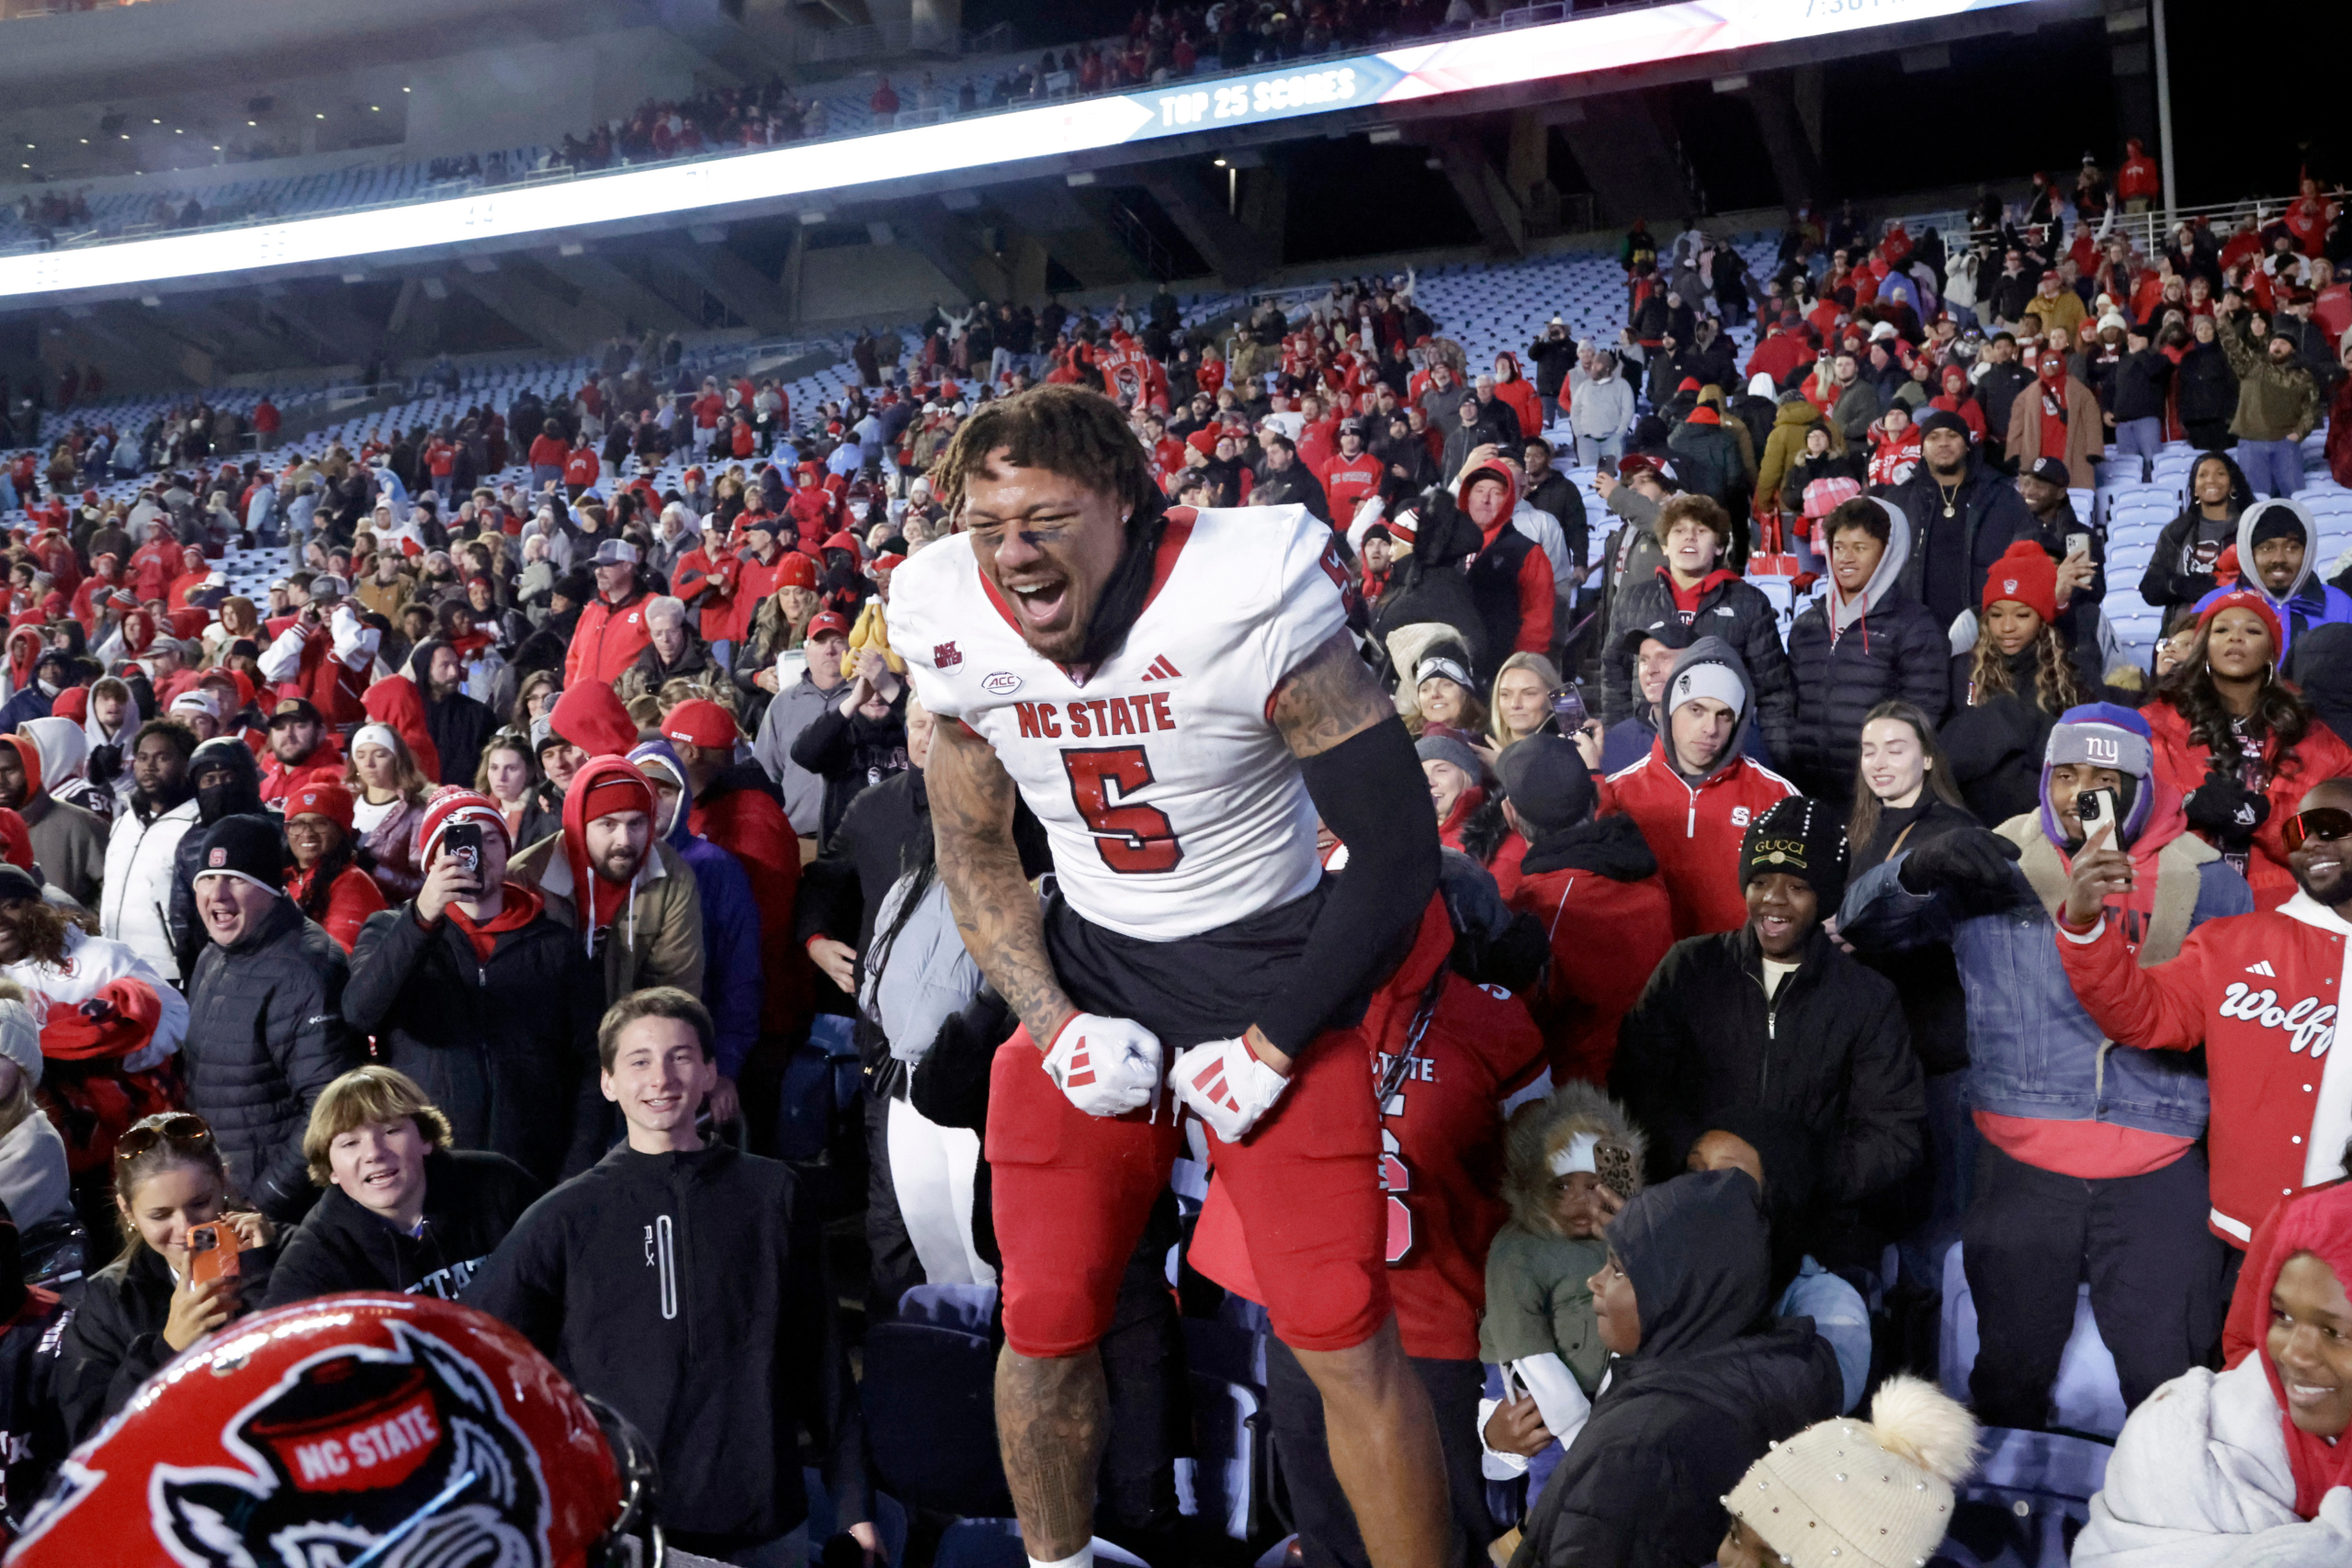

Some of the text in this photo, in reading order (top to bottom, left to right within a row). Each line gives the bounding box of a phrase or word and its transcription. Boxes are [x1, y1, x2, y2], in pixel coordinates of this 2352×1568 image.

[1159, 67, 1355, 126] TOP 25 SCORES
[933, 640, 956, 660] PACK
[988, 675, 1015, 687] ACC
[1013, 691, 1177, 739] NC STATE
[1059, 744, 1185, 874] 5
[1755, 839, 1805, 855] GUCCI
[644, 1224, 655, 1267] RLX
[294, 1404, 437, 1483] NC STATE
